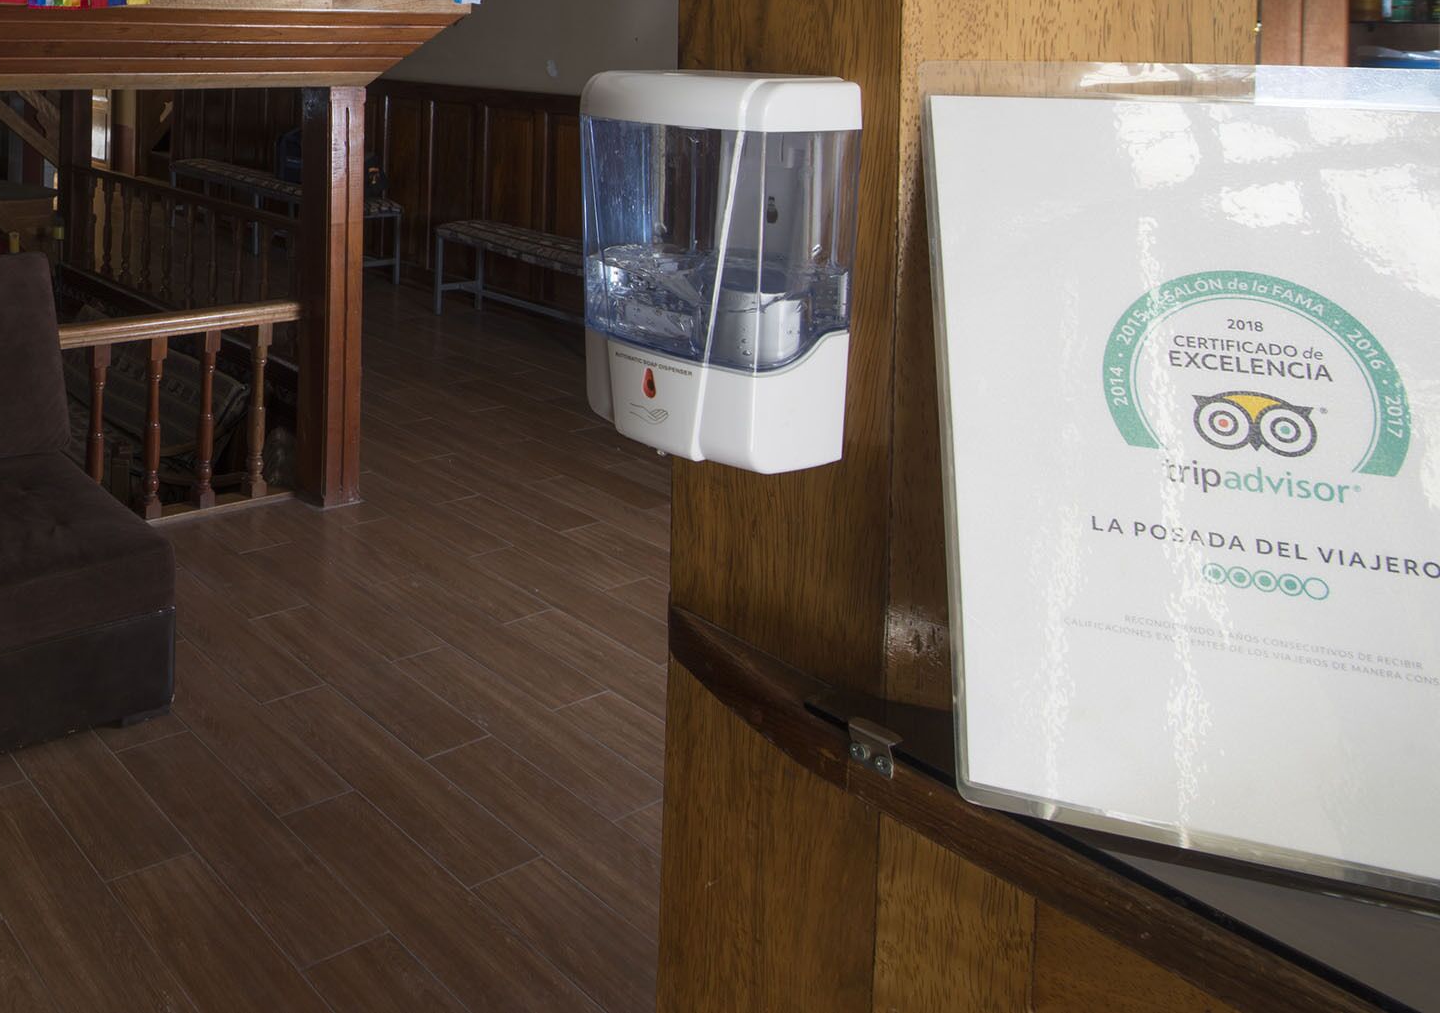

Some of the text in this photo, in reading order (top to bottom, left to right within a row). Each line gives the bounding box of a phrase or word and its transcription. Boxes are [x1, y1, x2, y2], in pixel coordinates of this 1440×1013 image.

[1227, 319, 1264, 332] 2018
[1110, 277, 1403, 439] 2014 2015 SALÓN de la FAMA 2016 2017
[1173, 335, 1324, 361] CERTIFICADO de
[658, 363, 693, 376] DISPENSER
[1169, 350, 1334, 382] EXCELENCIA
[1163, 459, 1350, 504] tripadvisor
[1092, 515, 1440, 579] LA POSADA DEL VIAJERO
[1229, 644, 1243, 654] DE
[1247, 648, 1269, 659] LOS
[1273, 652, 1329, 669] VIAJEROS
[1331, 661, 1347, 672] DE
[1351, 664, 1403, 682] MANERA
[1263, 636, 1354, 659] CONSECUTIVOS
[1358, 652, 1374, 662] DE
[1377, 655, 1424, 669] RECIBIR
